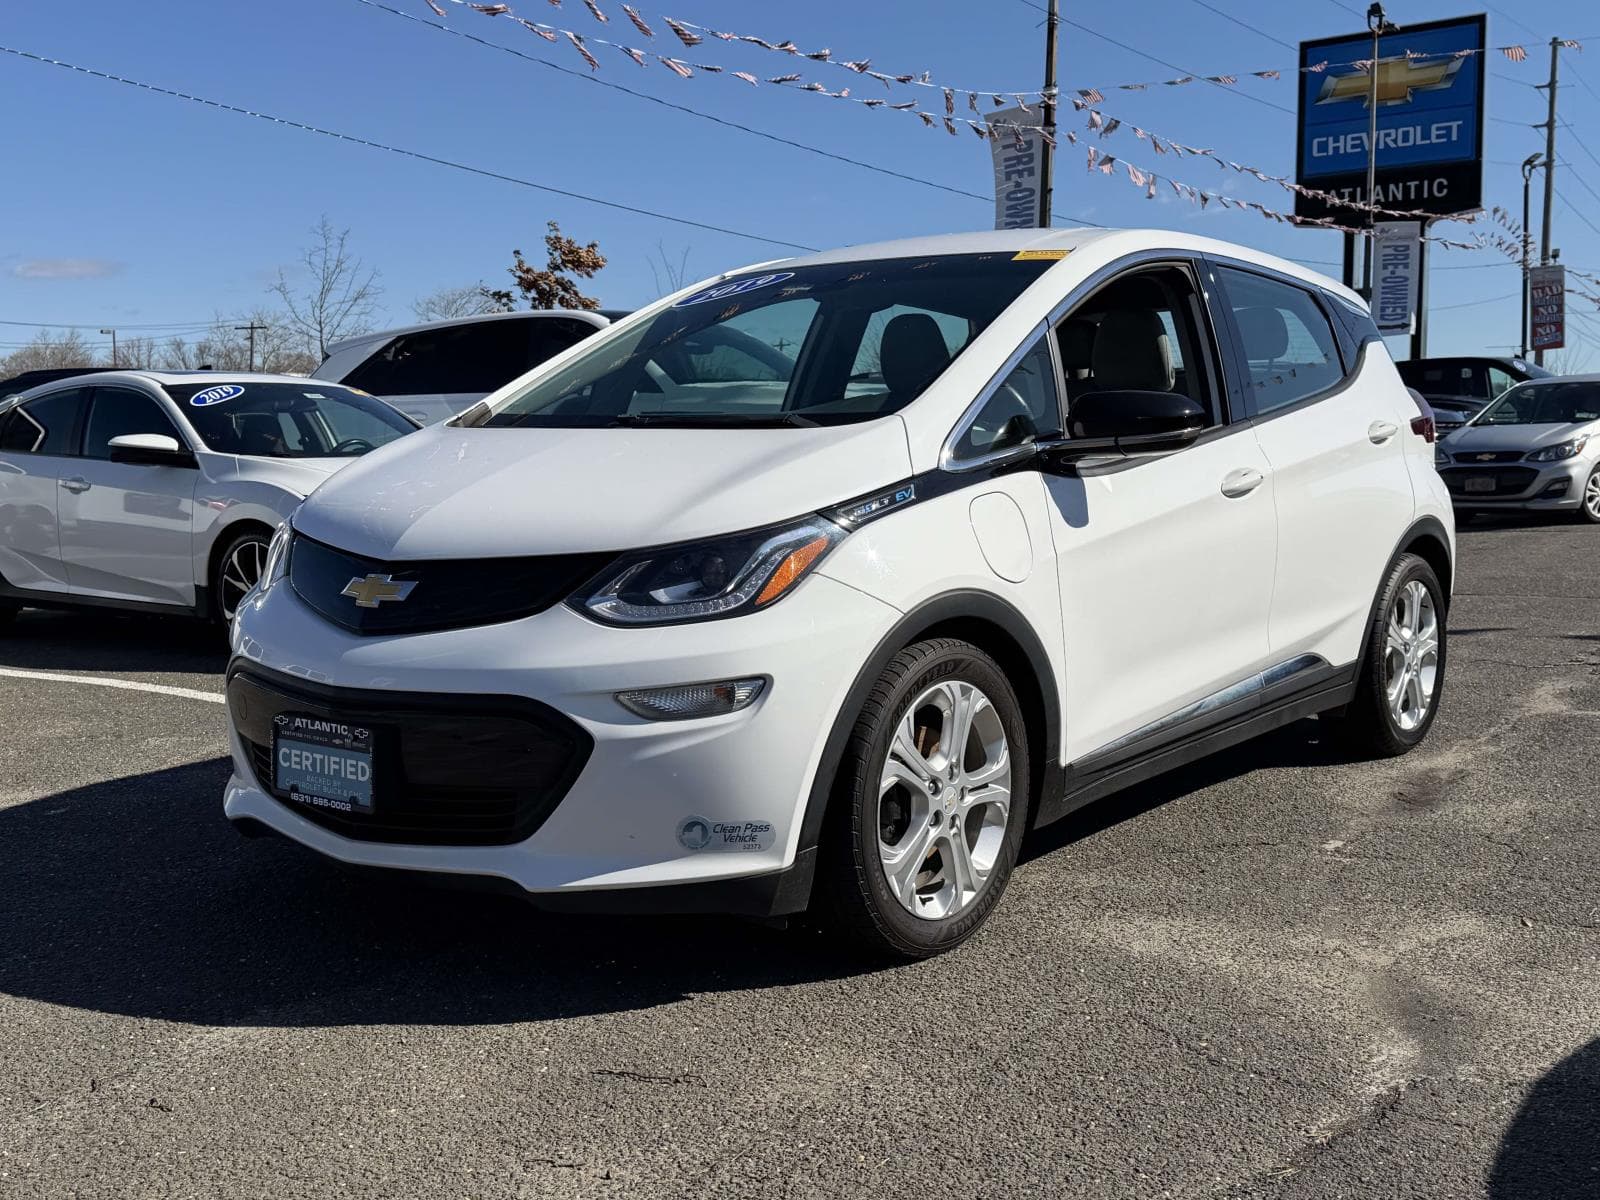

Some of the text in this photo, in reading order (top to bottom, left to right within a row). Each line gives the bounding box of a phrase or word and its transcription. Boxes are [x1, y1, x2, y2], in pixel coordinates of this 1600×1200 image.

[1312, 120, 1463, 158] CHEVROLET
[1379, 244, 1410, 321] PRE-OWNED
[200, 385, 234, 403] 2019
[895, 488, 912, 502] EV
[294, 717, 349, 736] ATLANTIC
[278, 747, 370, 782] CERTIFIED
[712, 822, 771, 834] Clean Pass
[723, 833, 759, 843] Vehicle
